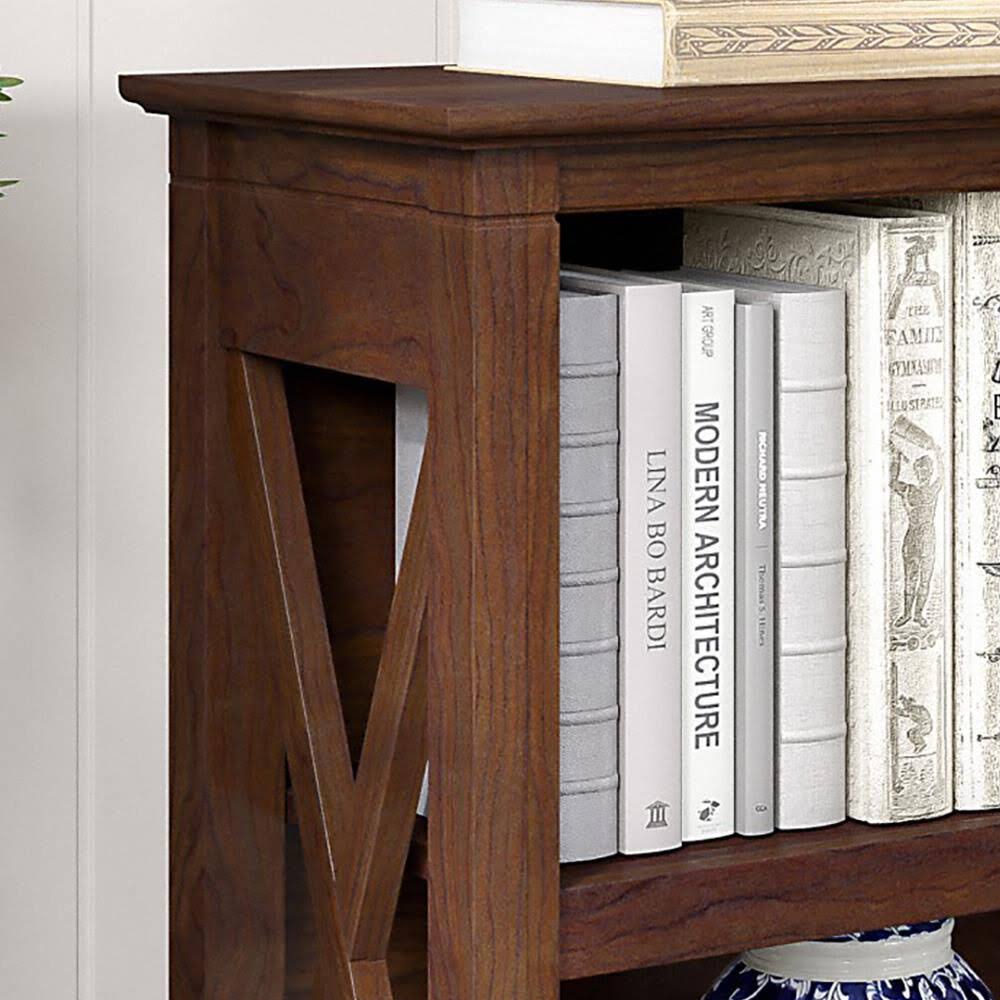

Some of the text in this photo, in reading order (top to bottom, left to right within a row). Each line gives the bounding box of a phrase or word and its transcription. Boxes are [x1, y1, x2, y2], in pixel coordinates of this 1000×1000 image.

[701, 304, 715, 359] ART GROUP
[758, 431, 768, 480] RICHARD
[758, 483, 768, 531] NEUTRA
[646, 450, 667, 652] LINA BO BARDI
[694, 402, 720, 750] MODERN ARCHITECTURE
